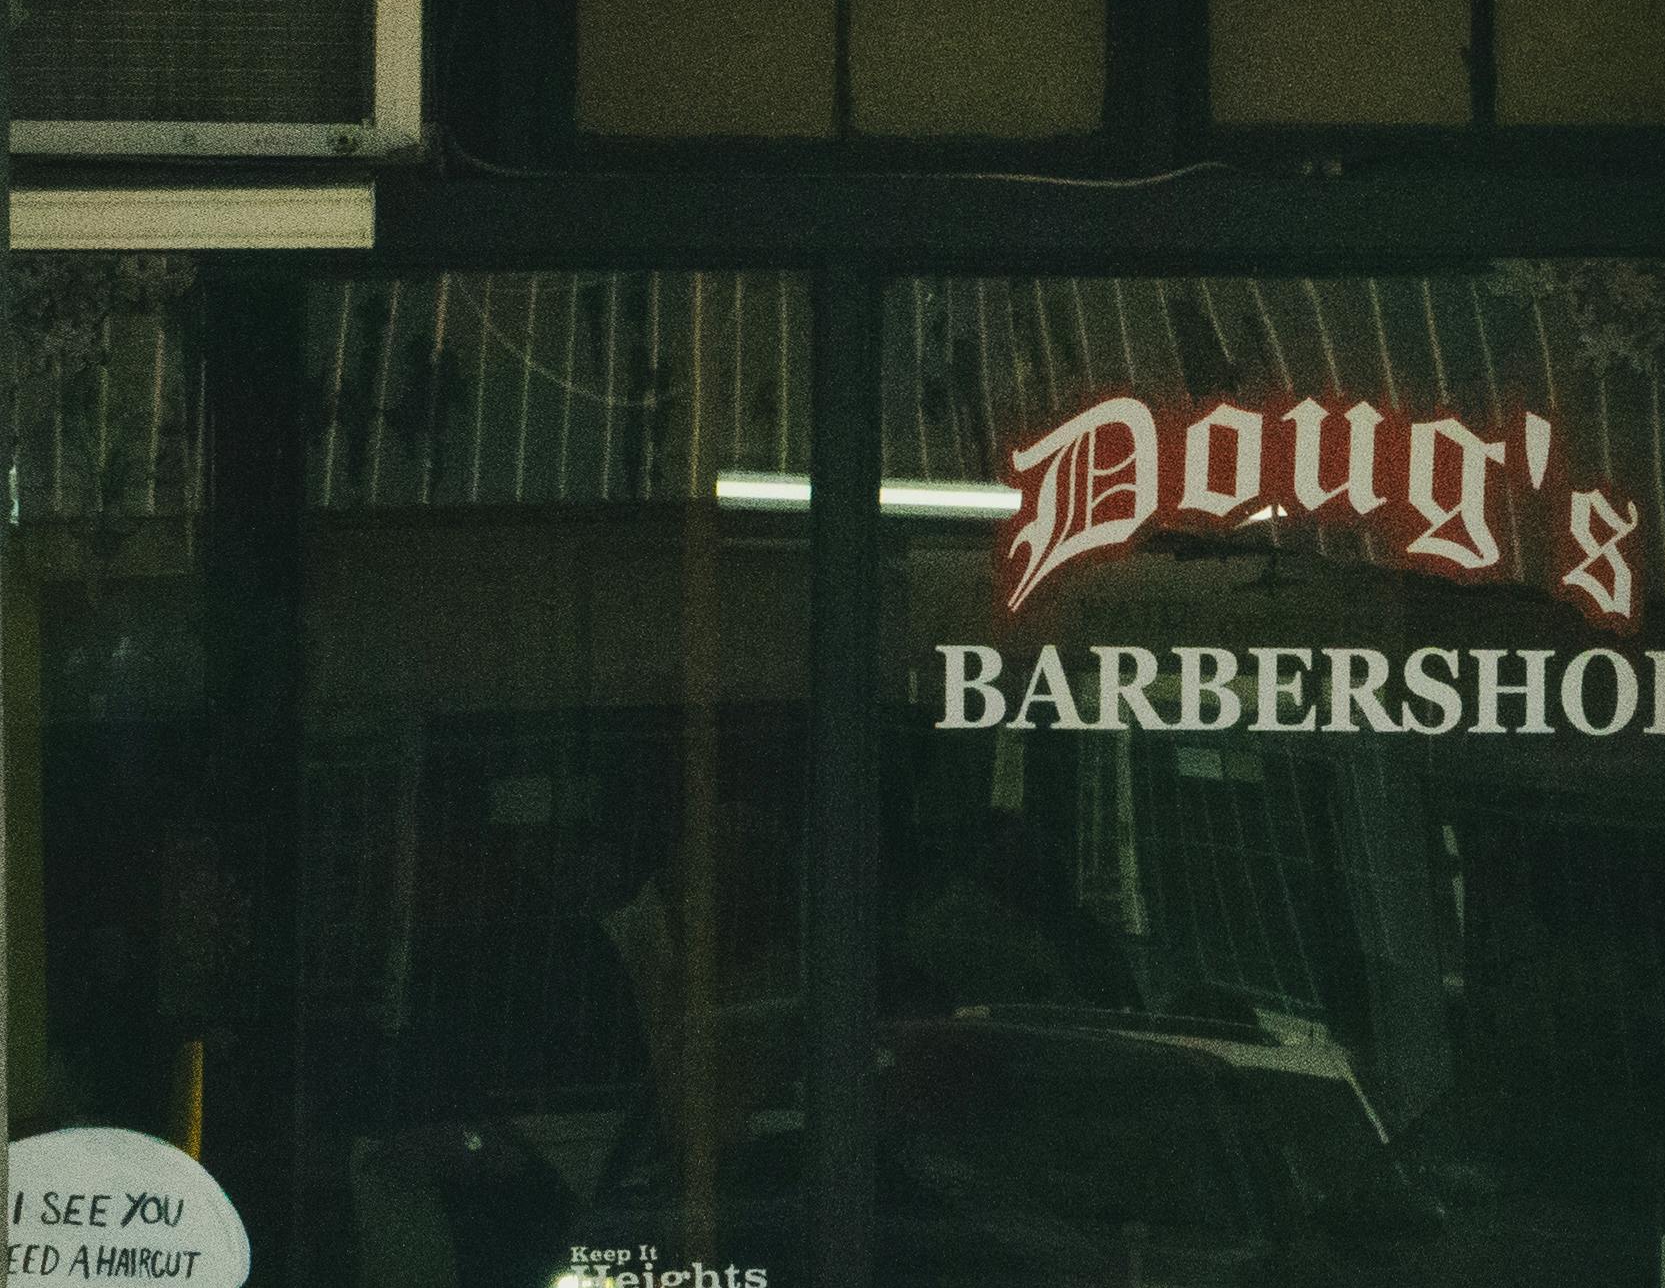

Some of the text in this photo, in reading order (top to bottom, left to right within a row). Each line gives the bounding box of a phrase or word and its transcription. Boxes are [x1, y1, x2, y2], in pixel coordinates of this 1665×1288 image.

[1008, 395, 1638, 619] Doug's
[13, 1191, 184, 1228] I SEE YOU
[8, 1244, 202, 1279] EED A HAIRCUT
[570, 1245, 658, 1265] Keep It
